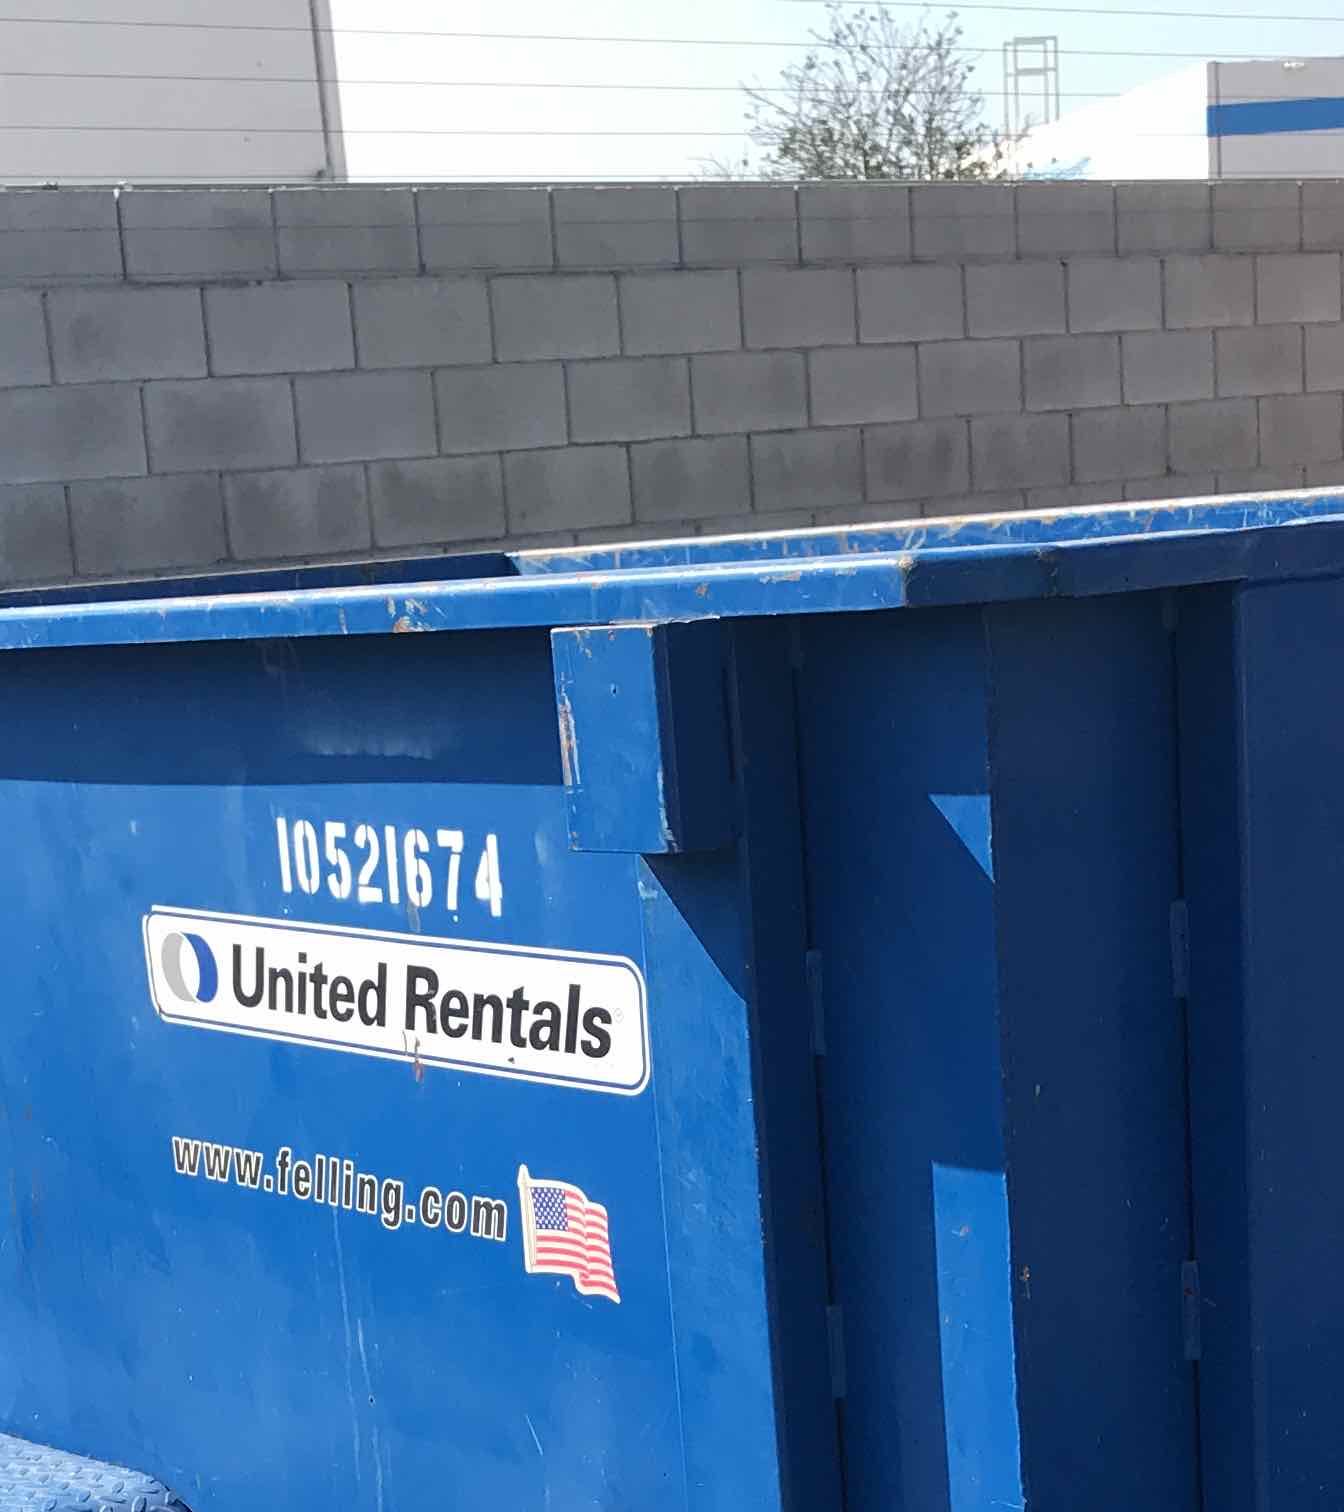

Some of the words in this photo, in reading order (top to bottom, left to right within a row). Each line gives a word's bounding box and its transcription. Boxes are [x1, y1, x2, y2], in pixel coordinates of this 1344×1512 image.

[275, 816, 503, 917] 10521674
[231, 943, 388, 1030] United
[405, 965, 614, 1060] Rentals
[171, 1136, 508, 1242] www.felling.com
